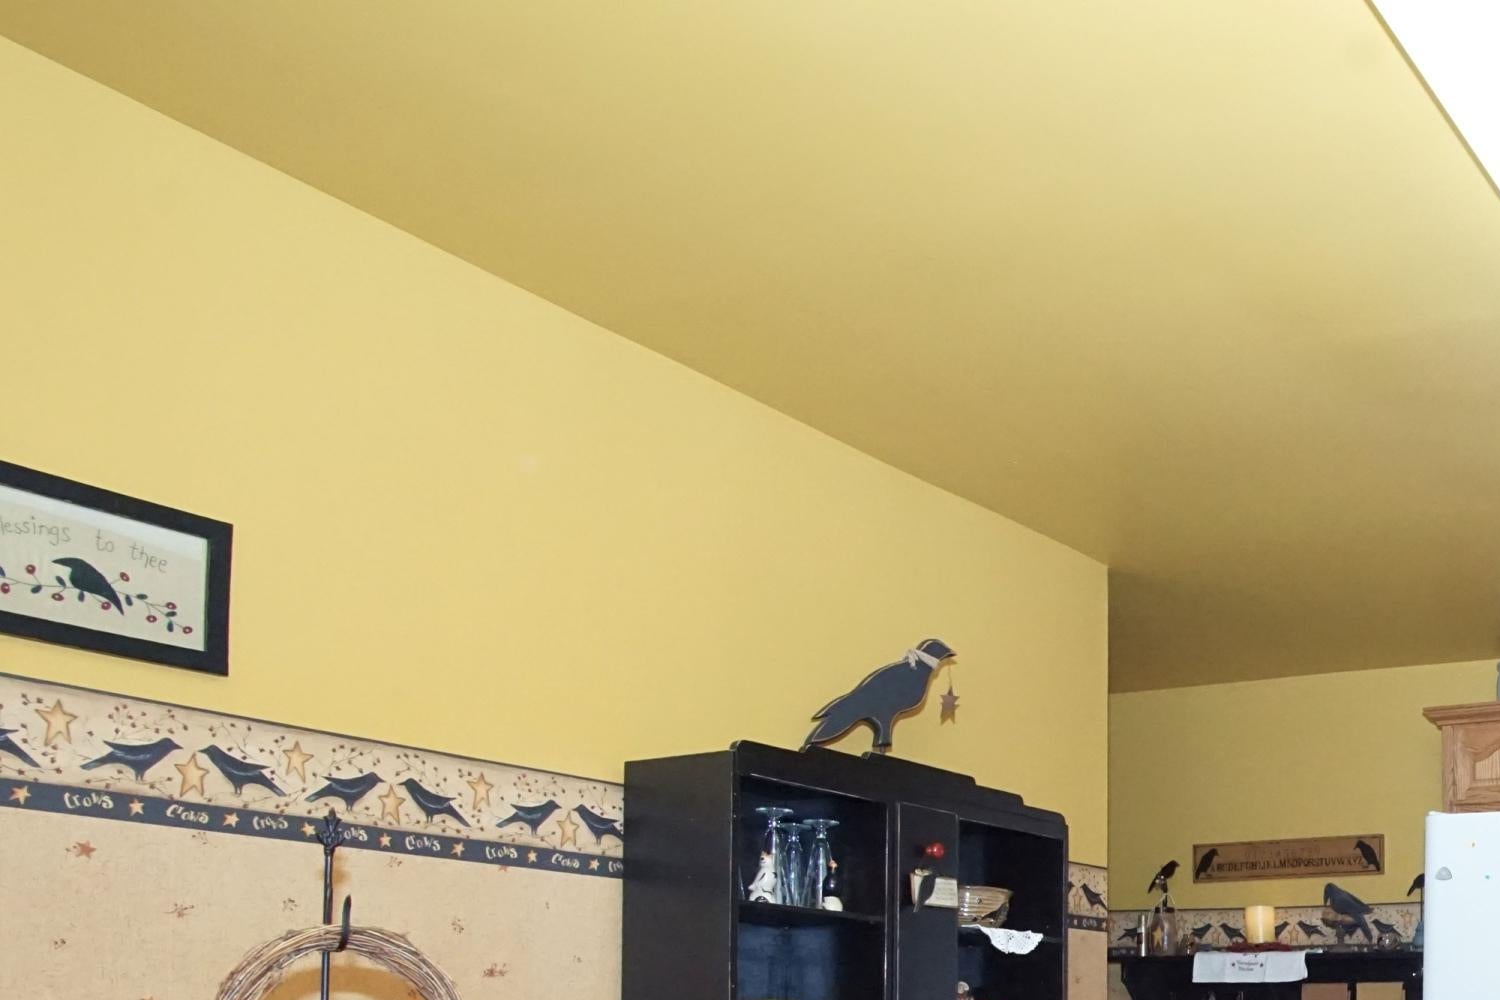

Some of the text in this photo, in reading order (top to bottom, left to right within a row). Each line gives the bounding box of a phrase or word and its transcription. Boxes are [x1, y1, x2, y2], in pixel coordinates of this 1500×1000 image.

[0, 515, 168, 573] lessings to thee
